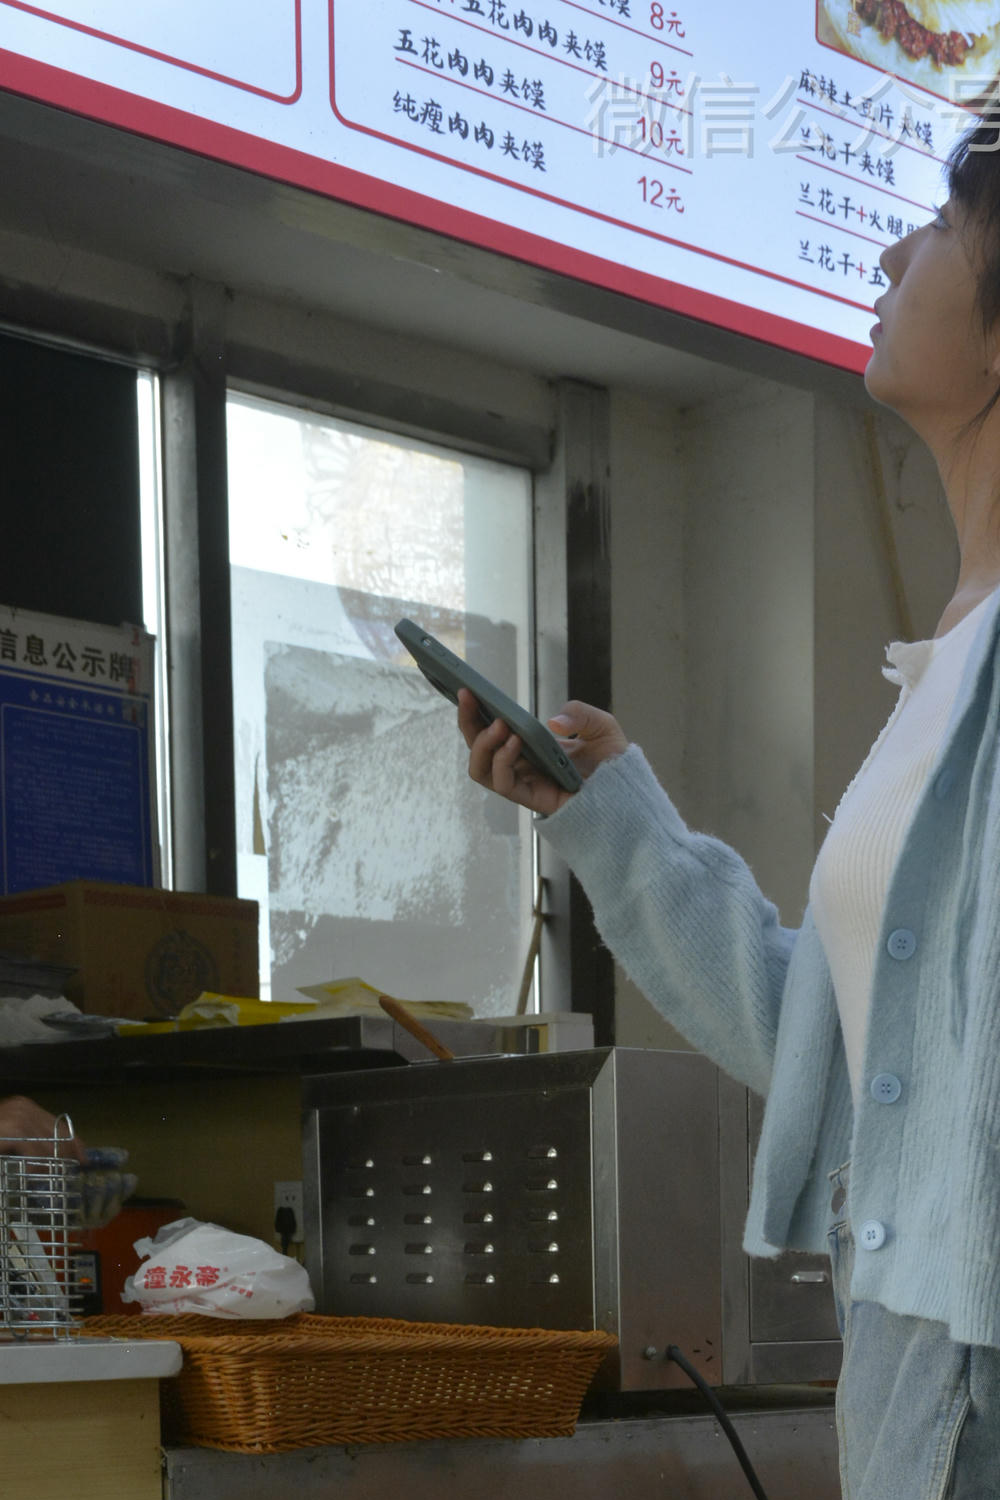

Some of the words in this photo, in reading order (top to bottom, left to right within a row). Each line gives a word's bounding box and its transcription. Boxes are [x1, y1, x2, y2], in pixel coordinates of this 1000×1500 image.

[650, 2, 686, 38] 8元
[393, 29, 547, 111] 五花肉肉夹馍
[637, 116, 685, 156] 10元
[650, 61, 685, 96] 9元
[393, 91, 547, 172] 纯瘦肉肉夹馍
[637, 176, 685, 214] 12元
[799, 127, 896, 187] 兰花干夹馍
